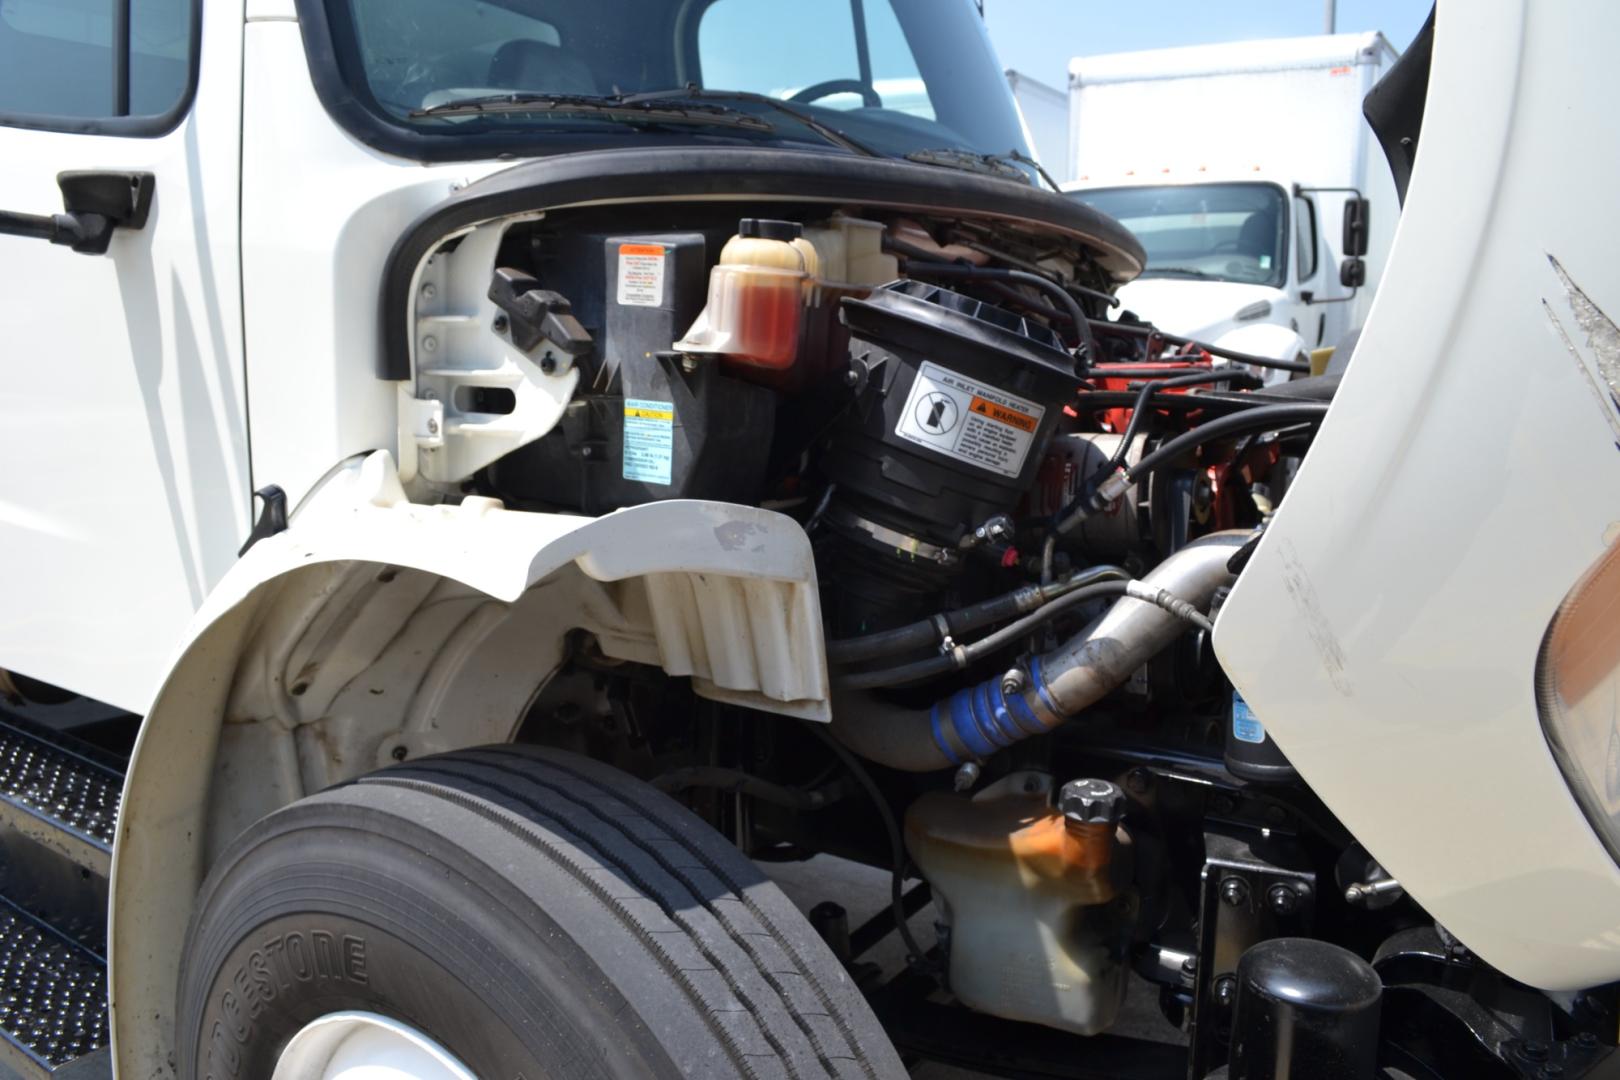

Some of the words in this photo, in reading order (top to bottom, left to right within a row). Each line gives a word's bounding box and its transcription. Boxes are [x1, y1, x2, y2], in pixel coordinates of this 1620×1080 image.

[943, 376, 955, 384] AIR
[957, 382, 975, 392] INLET
[977, 389, 1007, 405] MANIFOLD
[1009, 402, 1030, 413] HEATER
[992, 408, 1032, 429] WARNING
